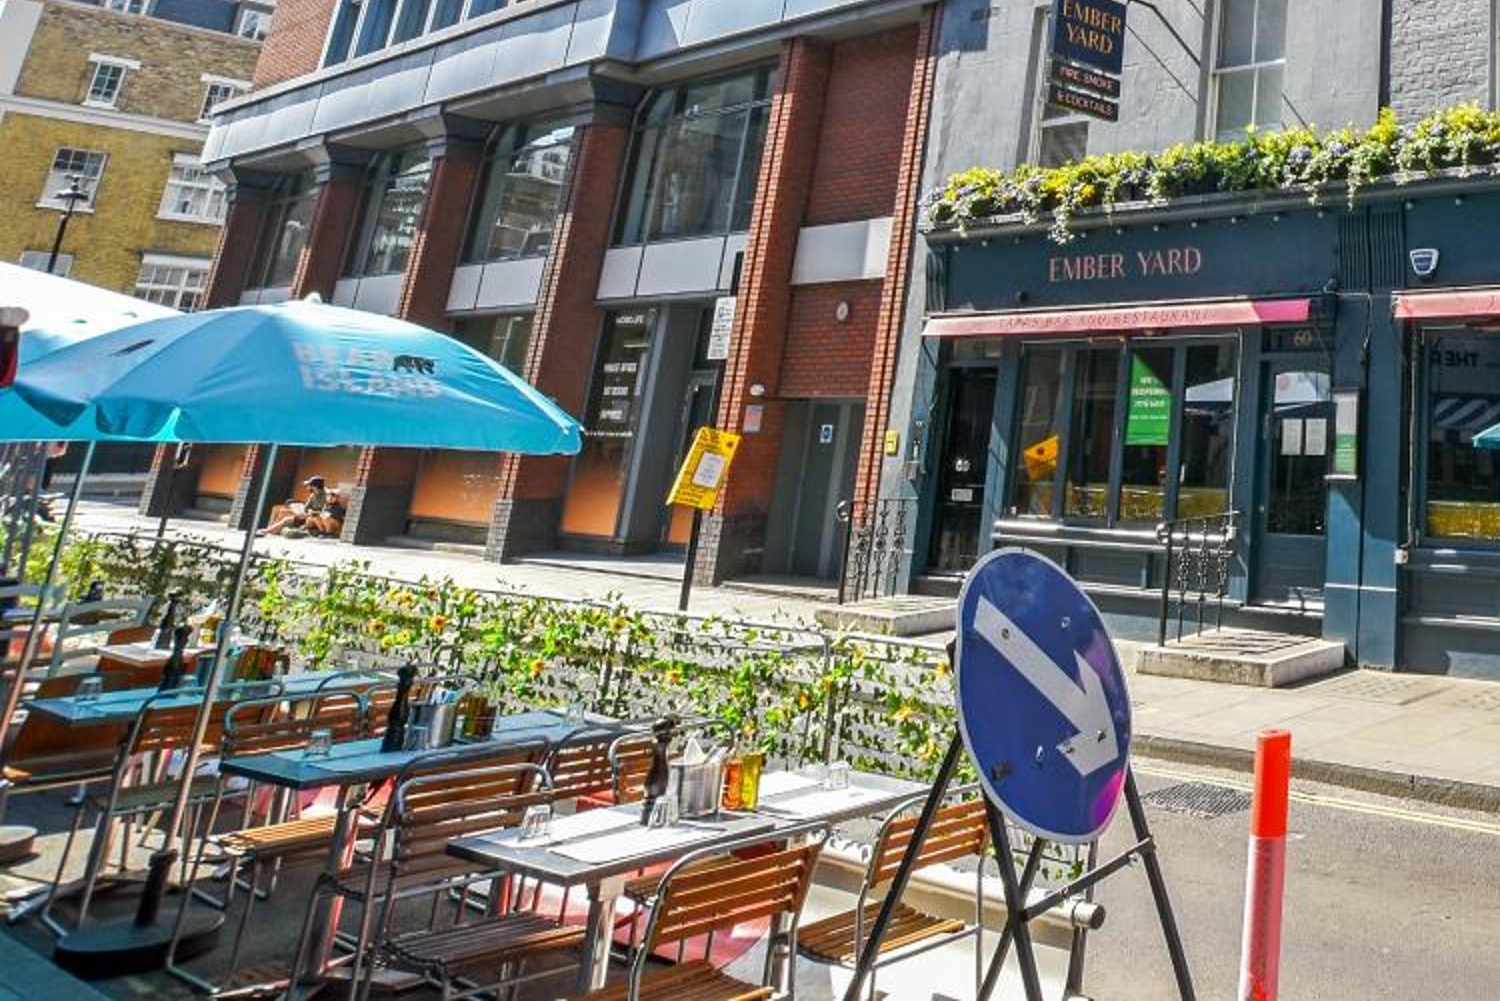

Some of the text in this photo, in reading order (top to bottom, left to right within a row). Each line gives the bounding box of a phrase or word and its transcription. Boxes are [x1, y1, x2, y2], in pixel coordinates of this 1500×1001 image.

[1065, 22, 1114, 54] YARD
[1065, 93, 1114, 116] COCKTAILS
[1049, 247, 1201, 282] EMBER YARD
[1295, 330, 1313, 346] 60
